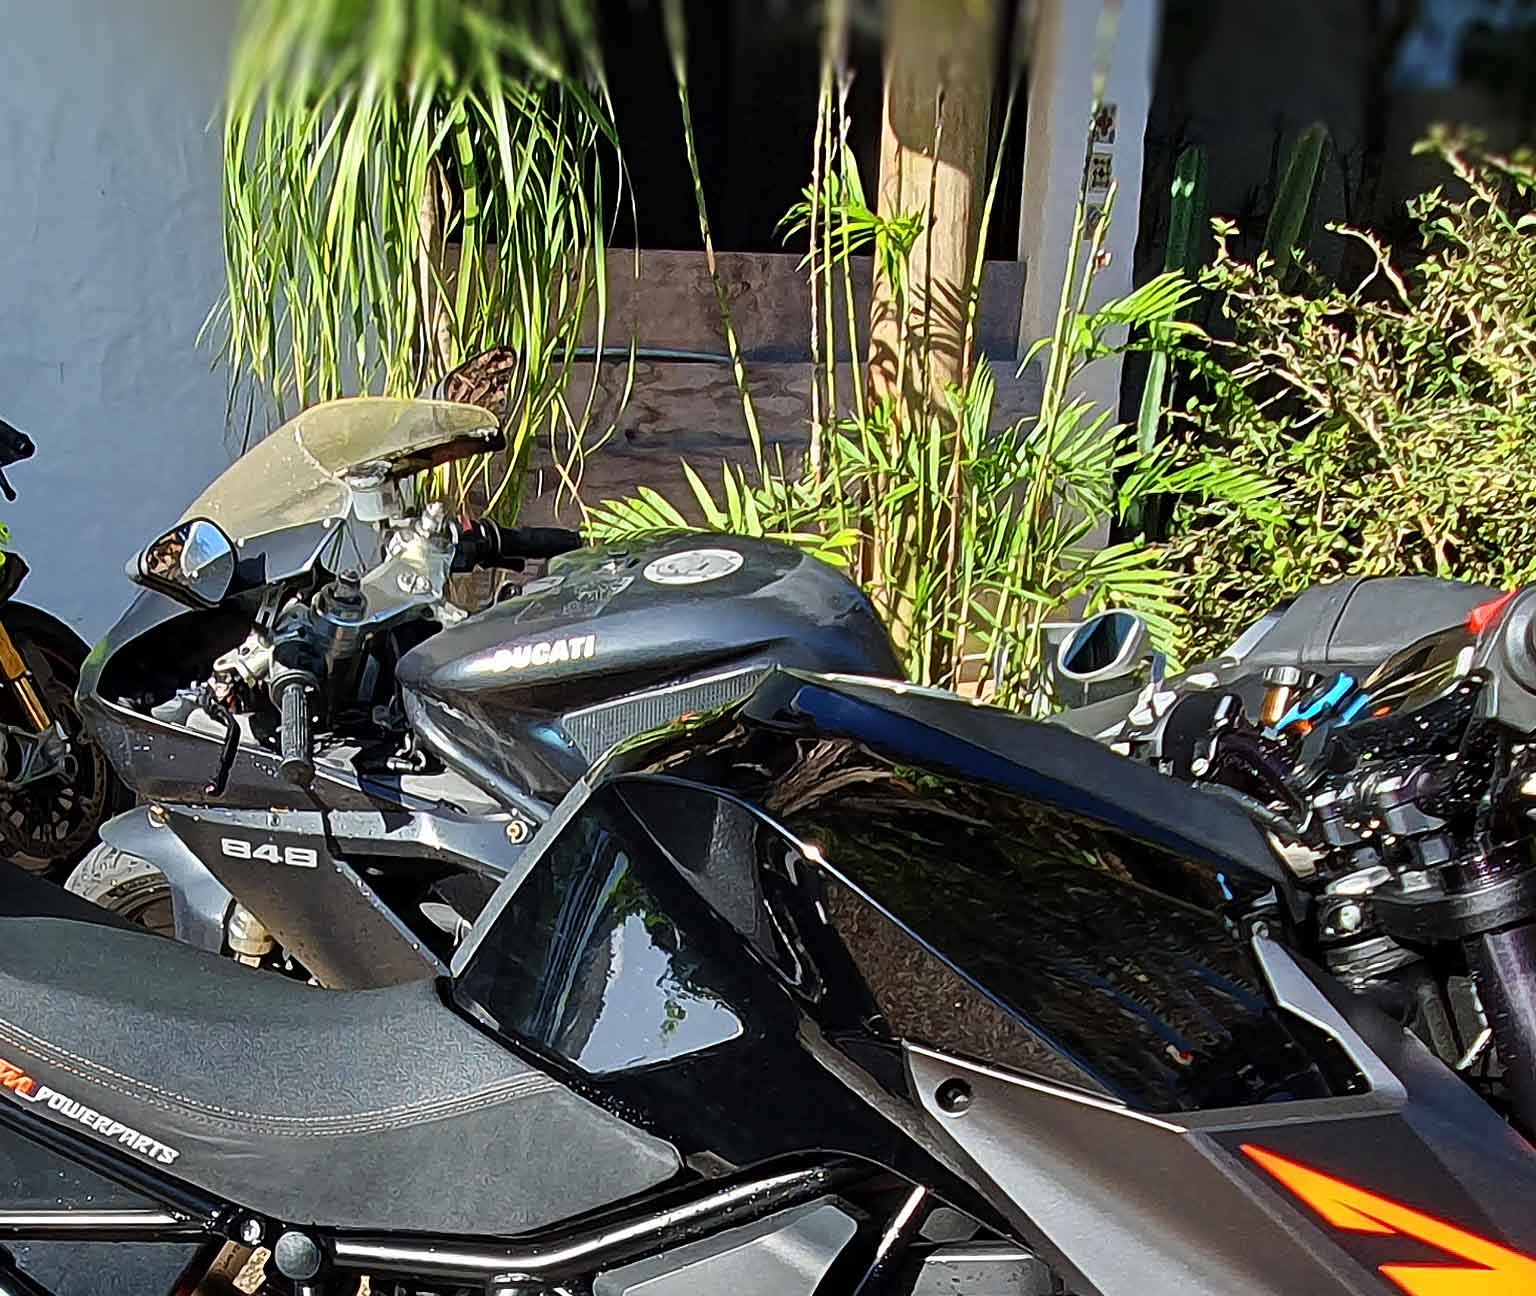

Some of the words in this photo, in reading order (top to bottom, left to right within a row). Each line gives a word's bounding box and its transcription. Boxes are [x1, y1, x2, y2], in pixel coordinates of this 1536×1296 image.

[491, 633, 597, 673] DUCATI
[221, 837, 318, 868] 848
[15, 1085, 181, 1166] POWERPARTS
